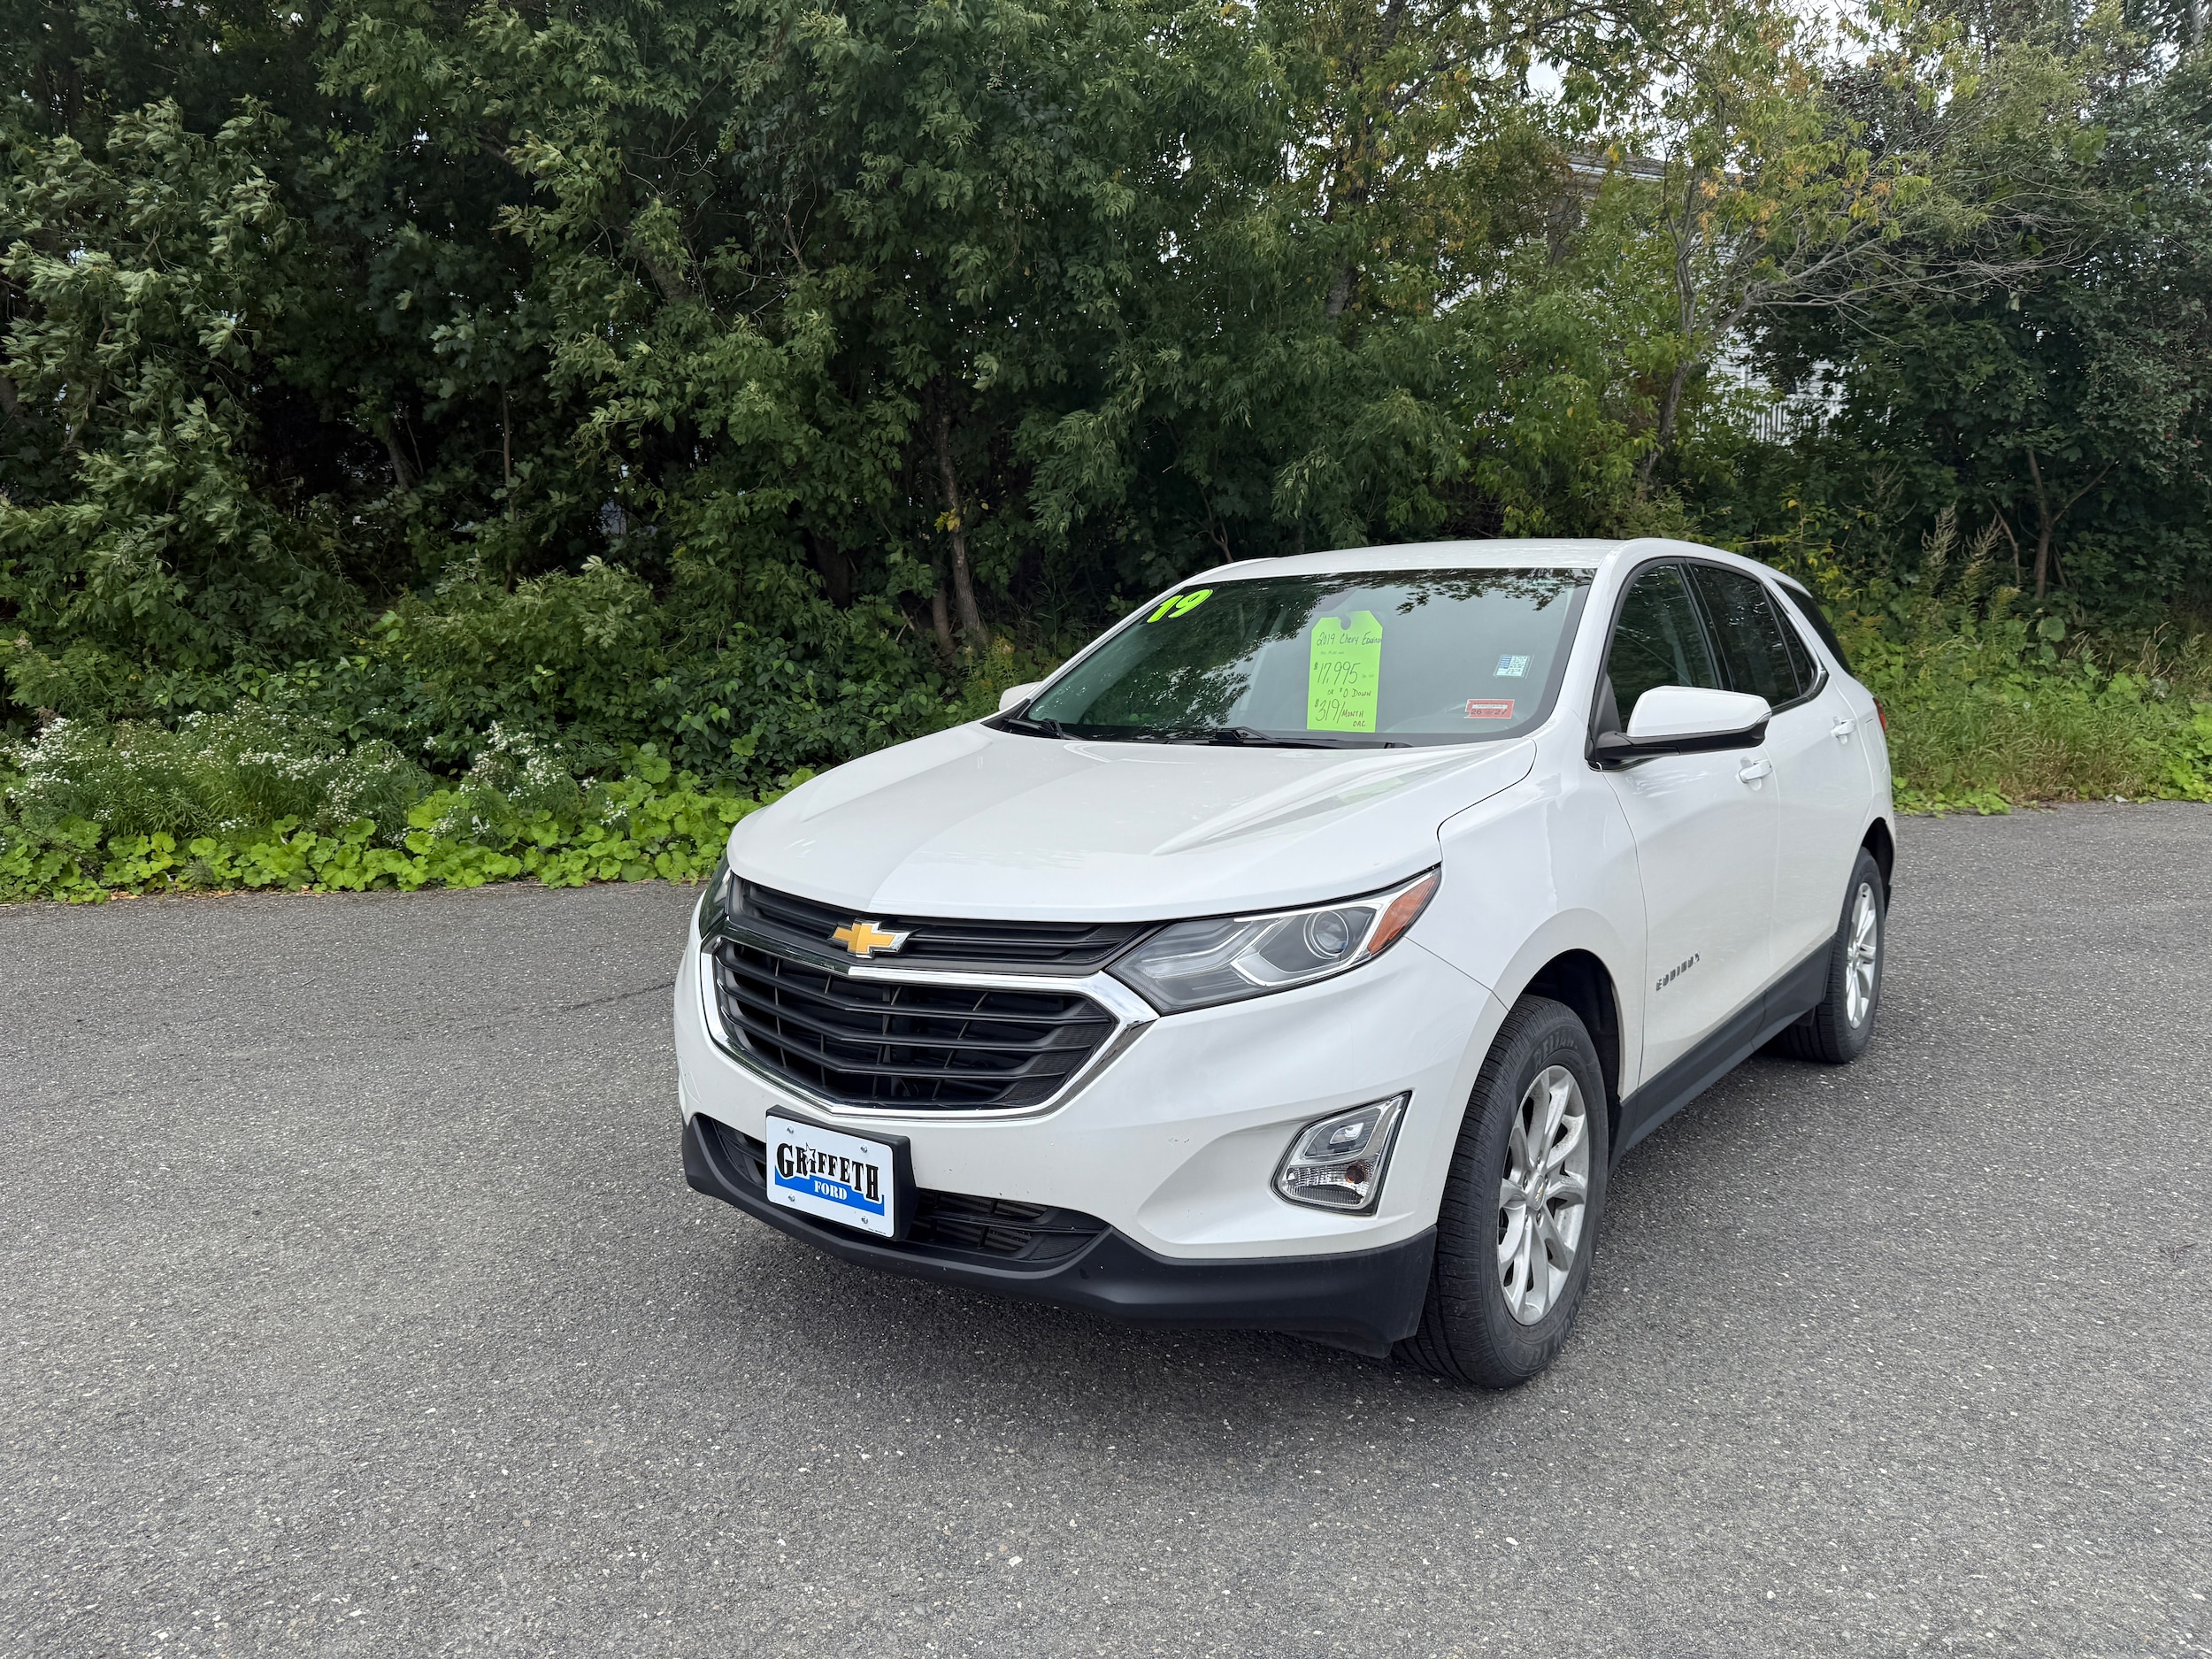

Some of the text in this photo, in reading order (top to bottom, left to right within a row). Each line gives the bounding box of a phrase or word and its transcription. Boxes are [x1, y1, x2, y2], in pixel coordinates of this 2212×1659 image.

[1147, 588, 1213, 624] 19
[1317, 631, 1335, 646] 2019
[777, 1142, 879, 1202] GRIFFETH
[813, 1179, 848, 1201] FORD
